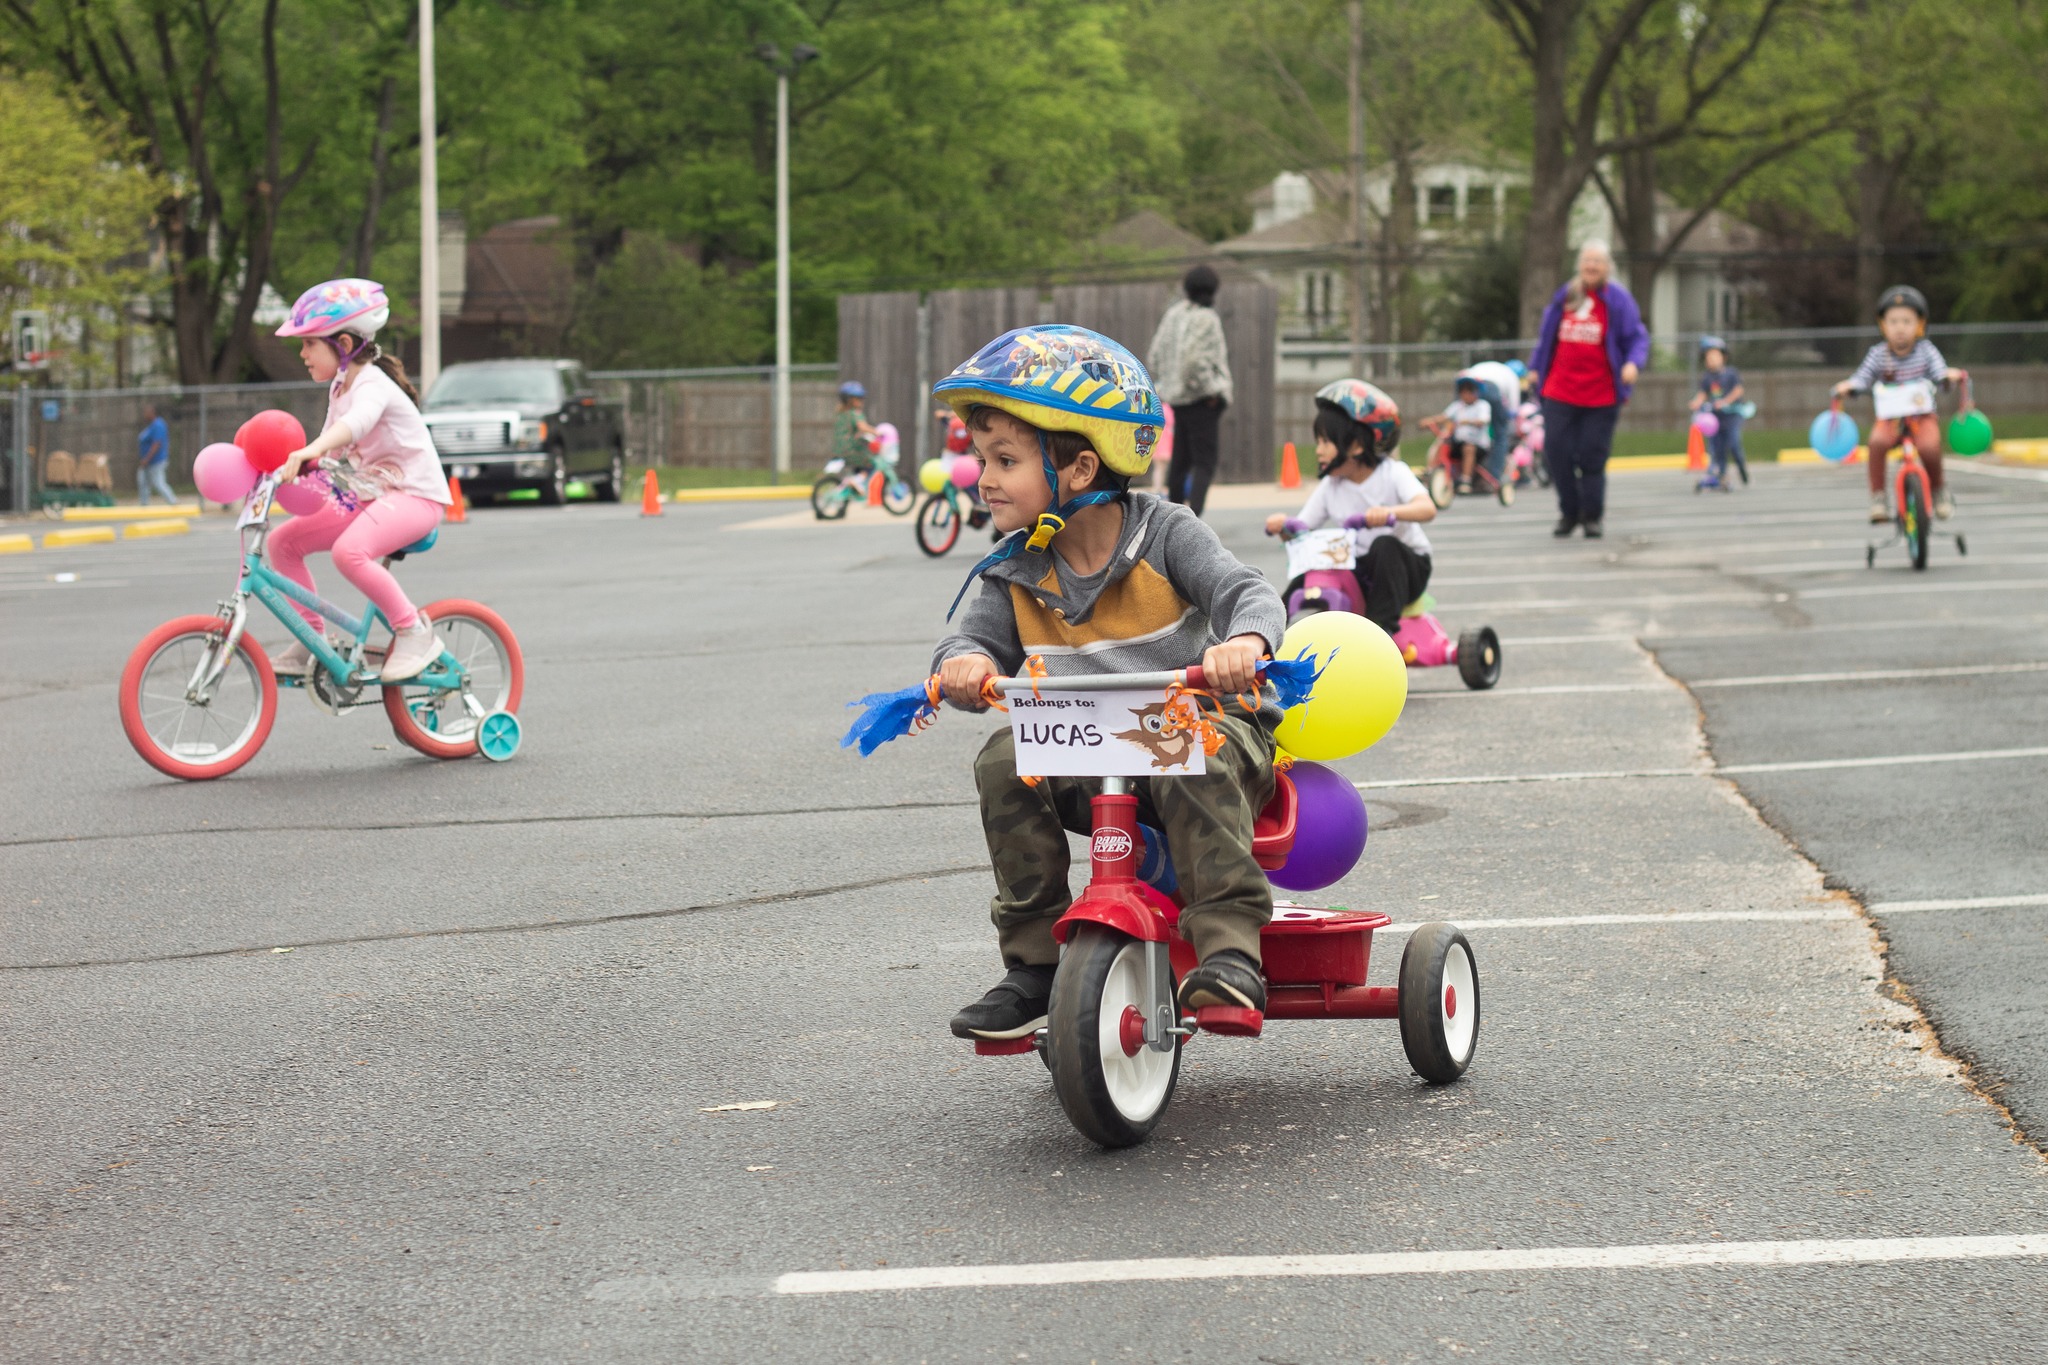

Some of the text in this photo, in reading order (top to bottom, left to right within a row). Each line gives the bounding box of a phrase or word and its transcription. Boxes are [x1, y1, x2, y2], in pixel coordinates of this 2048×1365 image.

[1013, 698, 1096, 709] Belongs to:
[1020, 723, 1103, 746] LUCAS
[1095, 836, 1127, 845] RADIO
[1093, 844, 1125, 852] FLYER
